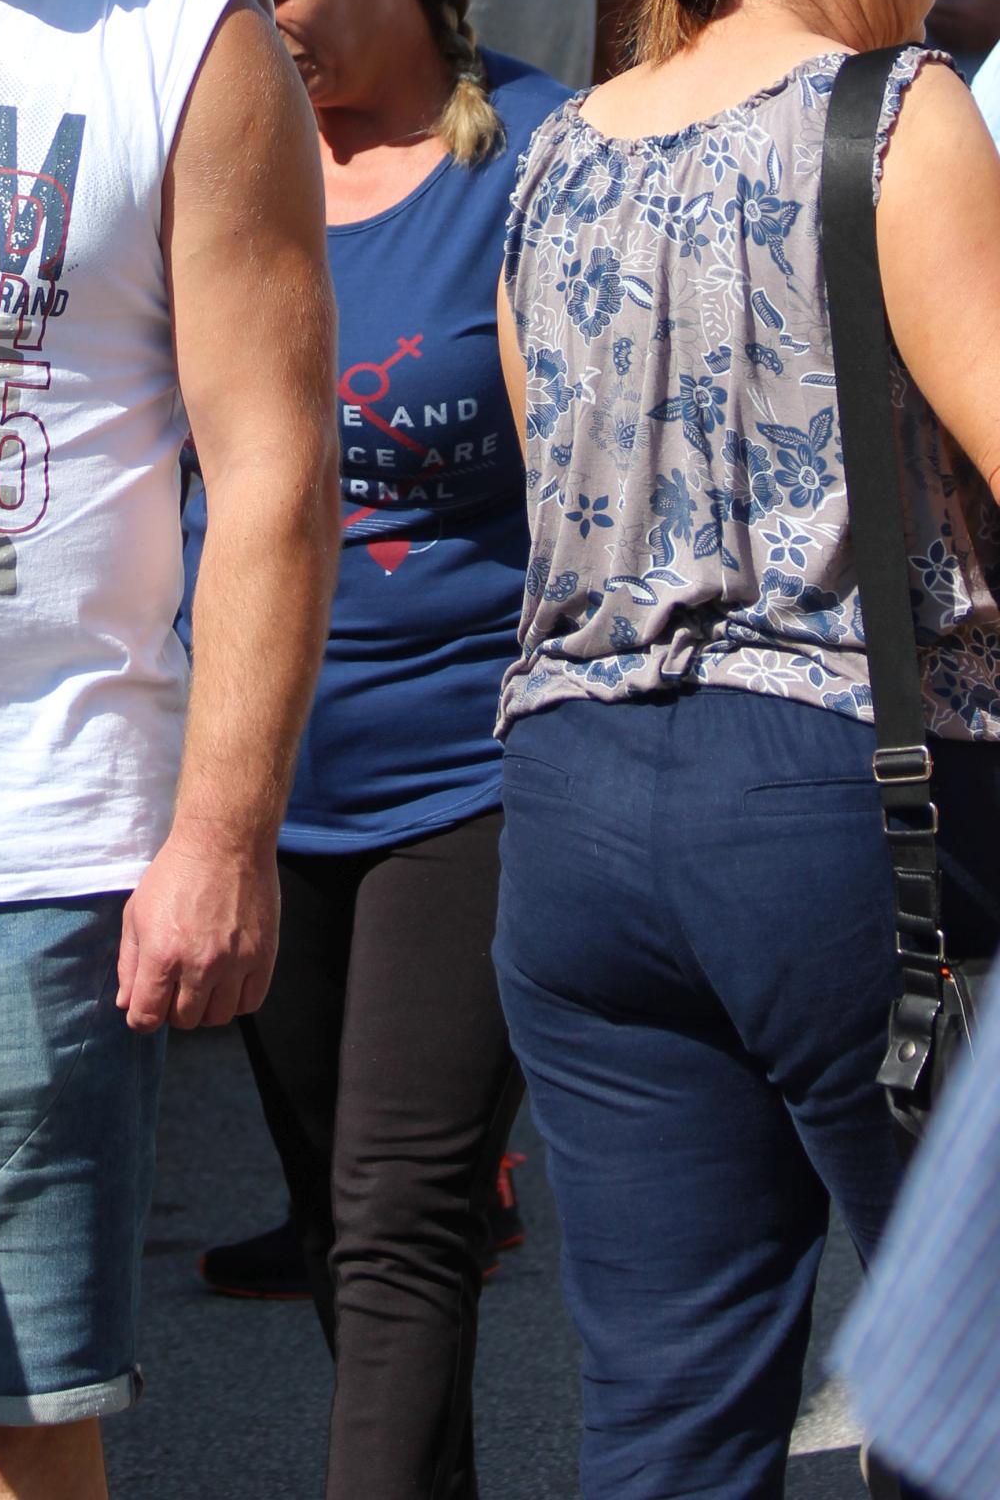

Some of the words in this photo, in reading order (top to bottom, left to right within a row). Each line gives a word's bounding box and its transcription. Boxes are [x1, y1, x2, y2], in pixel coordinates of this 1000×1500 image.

[343, 404, 363, 427] E
[389, 398, 479, 428] AND
[347, 445, 396, 468] CE
[422, 432, 498, 468] ARE
[340, 478, 454, 501] RNAL
